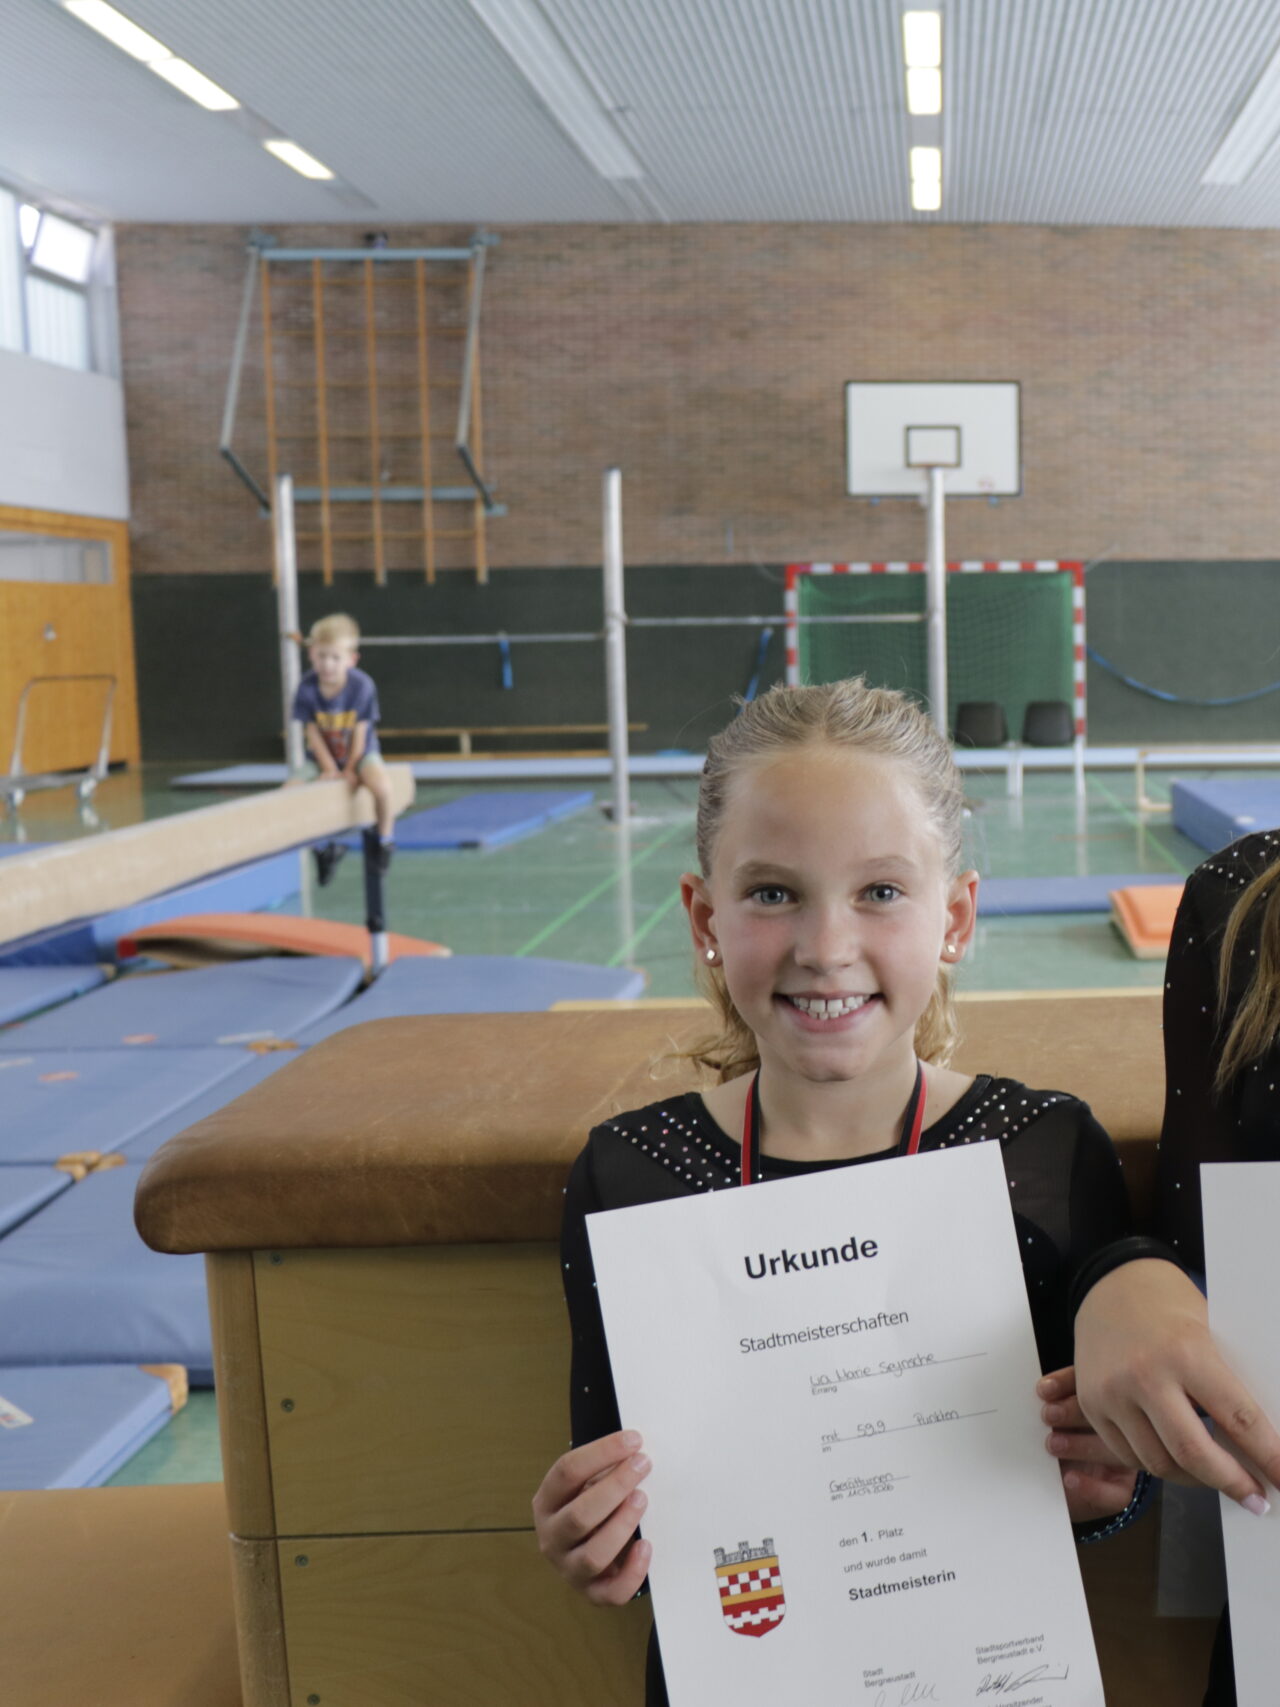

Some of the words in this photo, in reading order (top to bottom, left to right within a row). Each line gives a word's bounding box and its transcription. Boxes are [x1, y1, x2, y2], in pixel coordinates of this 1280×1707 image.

[743, 1236, 879, 1280] Urkunde
[740, 1308, 910, 1354] Stadtmeisterschaften
[839, 1537, 859, 1548] den
[878, 1528, 904, 1540] Platz
[843, 1561, 863, 1573] und
[865, 1555, 897, 1569] wurde
[899, 1548, 928, 1561] damit
[848, 1569, 956, 1601] Stadtmeisterin
[863, 1668, 883, 1679] Stadt
